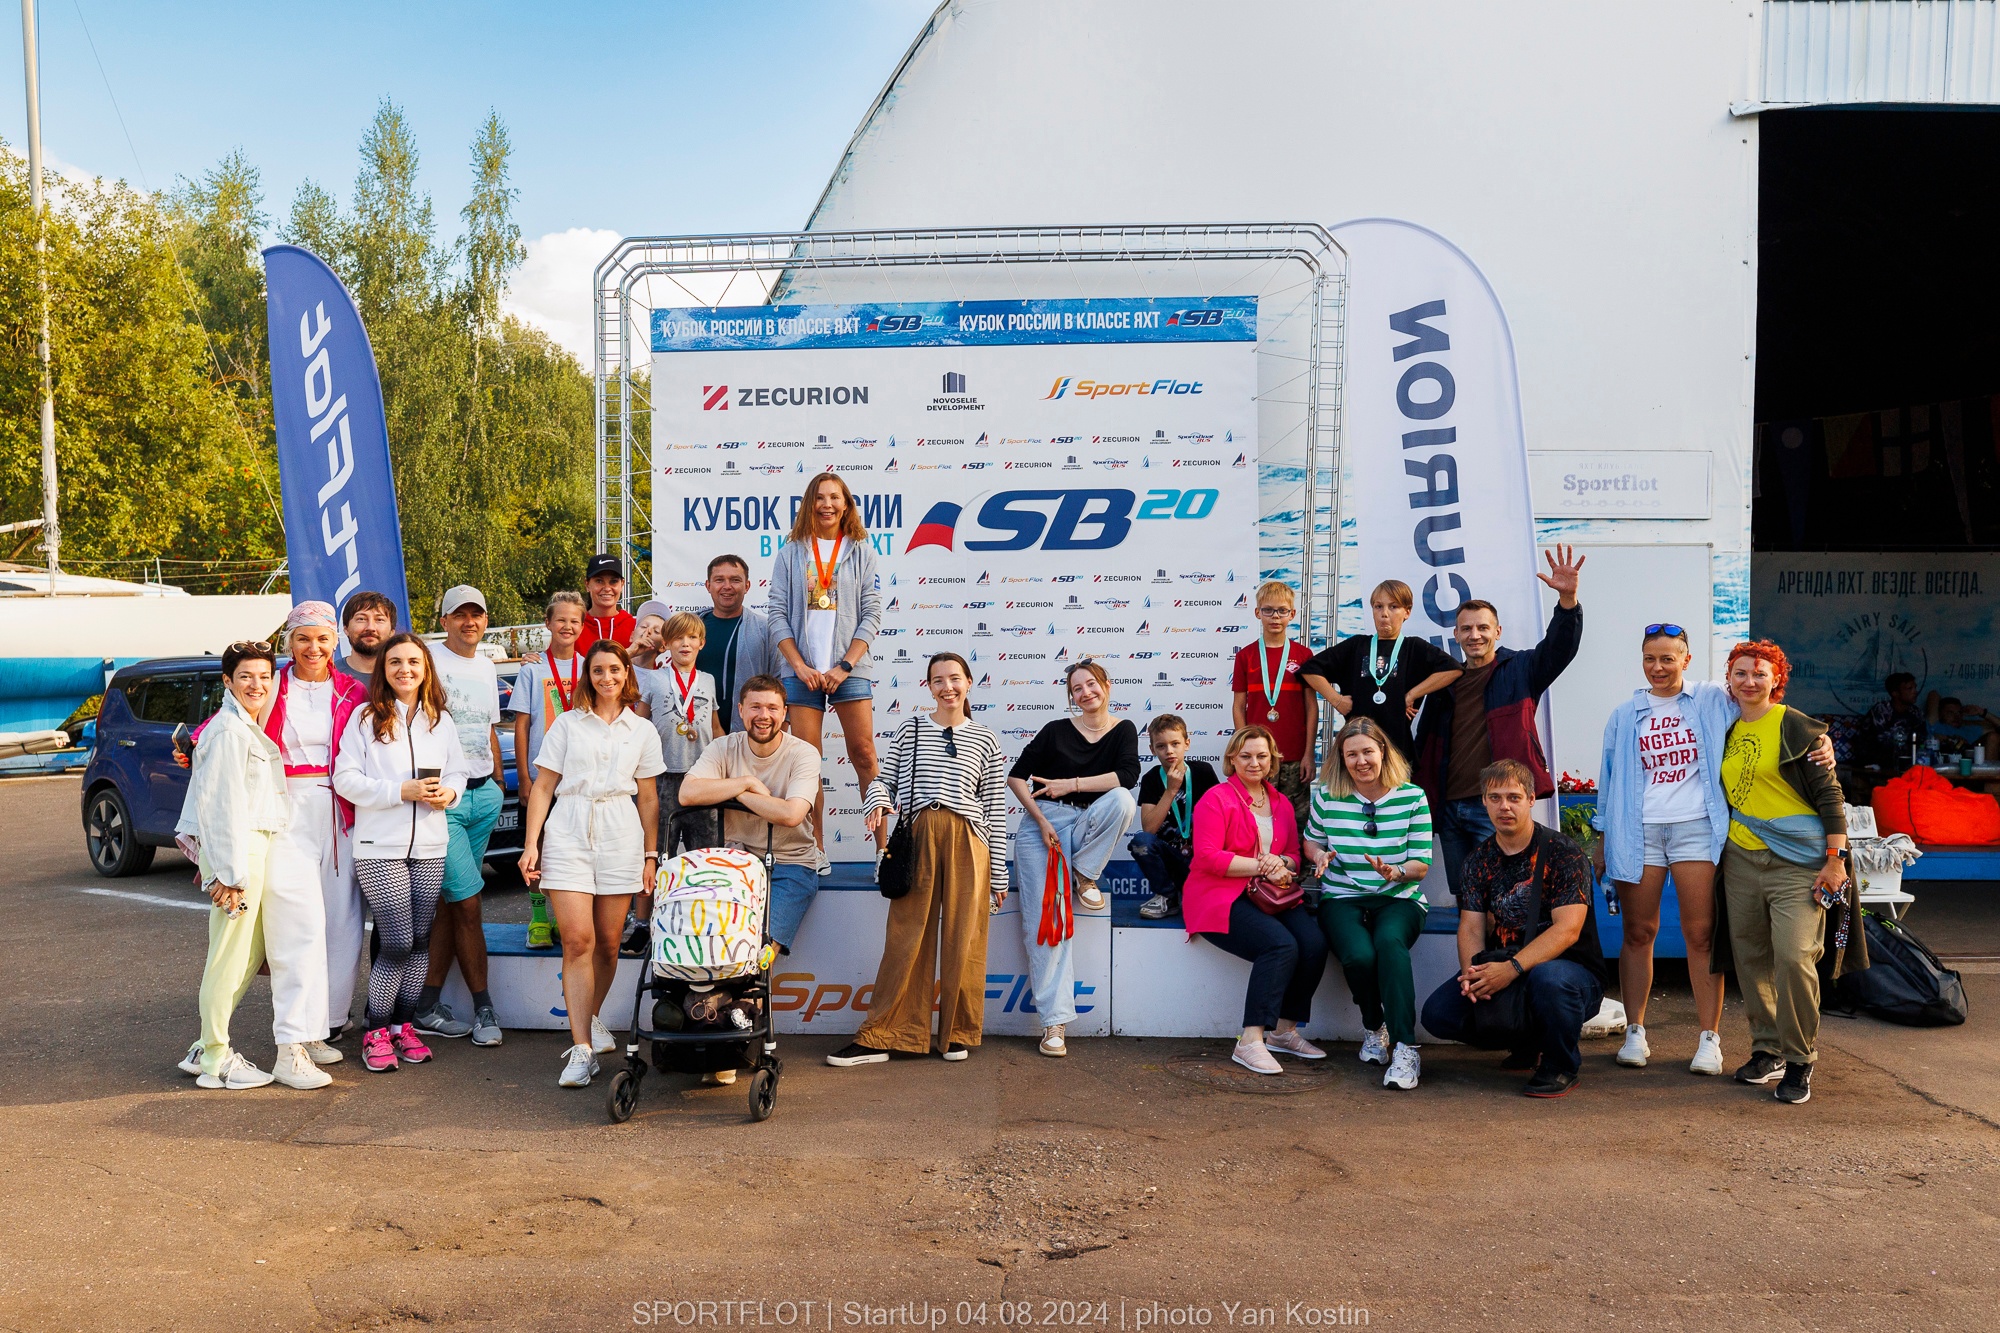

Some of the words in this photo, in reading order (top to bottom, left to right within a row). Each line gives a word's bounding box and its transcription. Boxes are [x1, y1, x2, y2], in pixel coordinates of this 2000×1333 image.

[662, 319, 708, 338] КУБОК
[710, 318, 762, 336] РОССИИ
[766, 318, 776, 336] В
[778, 317, 831, 335] КЛАССЕ
[834, 316, 860, 334] ЯХТ
[959, 314, 1004, 332] КУБОК
[1008, 313, 1060, 330] РОССИИ
[1064, 313, 1074, 329] В
[1076, 312, 1130, 329] КЛАССЕ
[1134, 311, 1160, 328] ЯХТ
[738, 386, 868, 406] ZECURION
[1074, 379, 1202, 400] SportFlot
[1563, 474, 1658, 496] Sportflot
[683, 496, 780, 532] КУБОК
[760, 534, 772, 558] В
[1778, 571, 1832, 596] АРЕНДА
[1838, 572, 1867, 594] ЯХТ.
[1872, 572, 1920, 597] ВЕЗДЕ.
[1926, 572, 1983, 597] ВСЕГДА.
[1837, 612, 1880, 643] FAIRY
[1889, 614, 1921, 643] SAIL
[1650, 716, 1680, 730] LOS
[1639, 729, 1696, 751] NGELE
[1652, 768, 1686, 785] 1990
